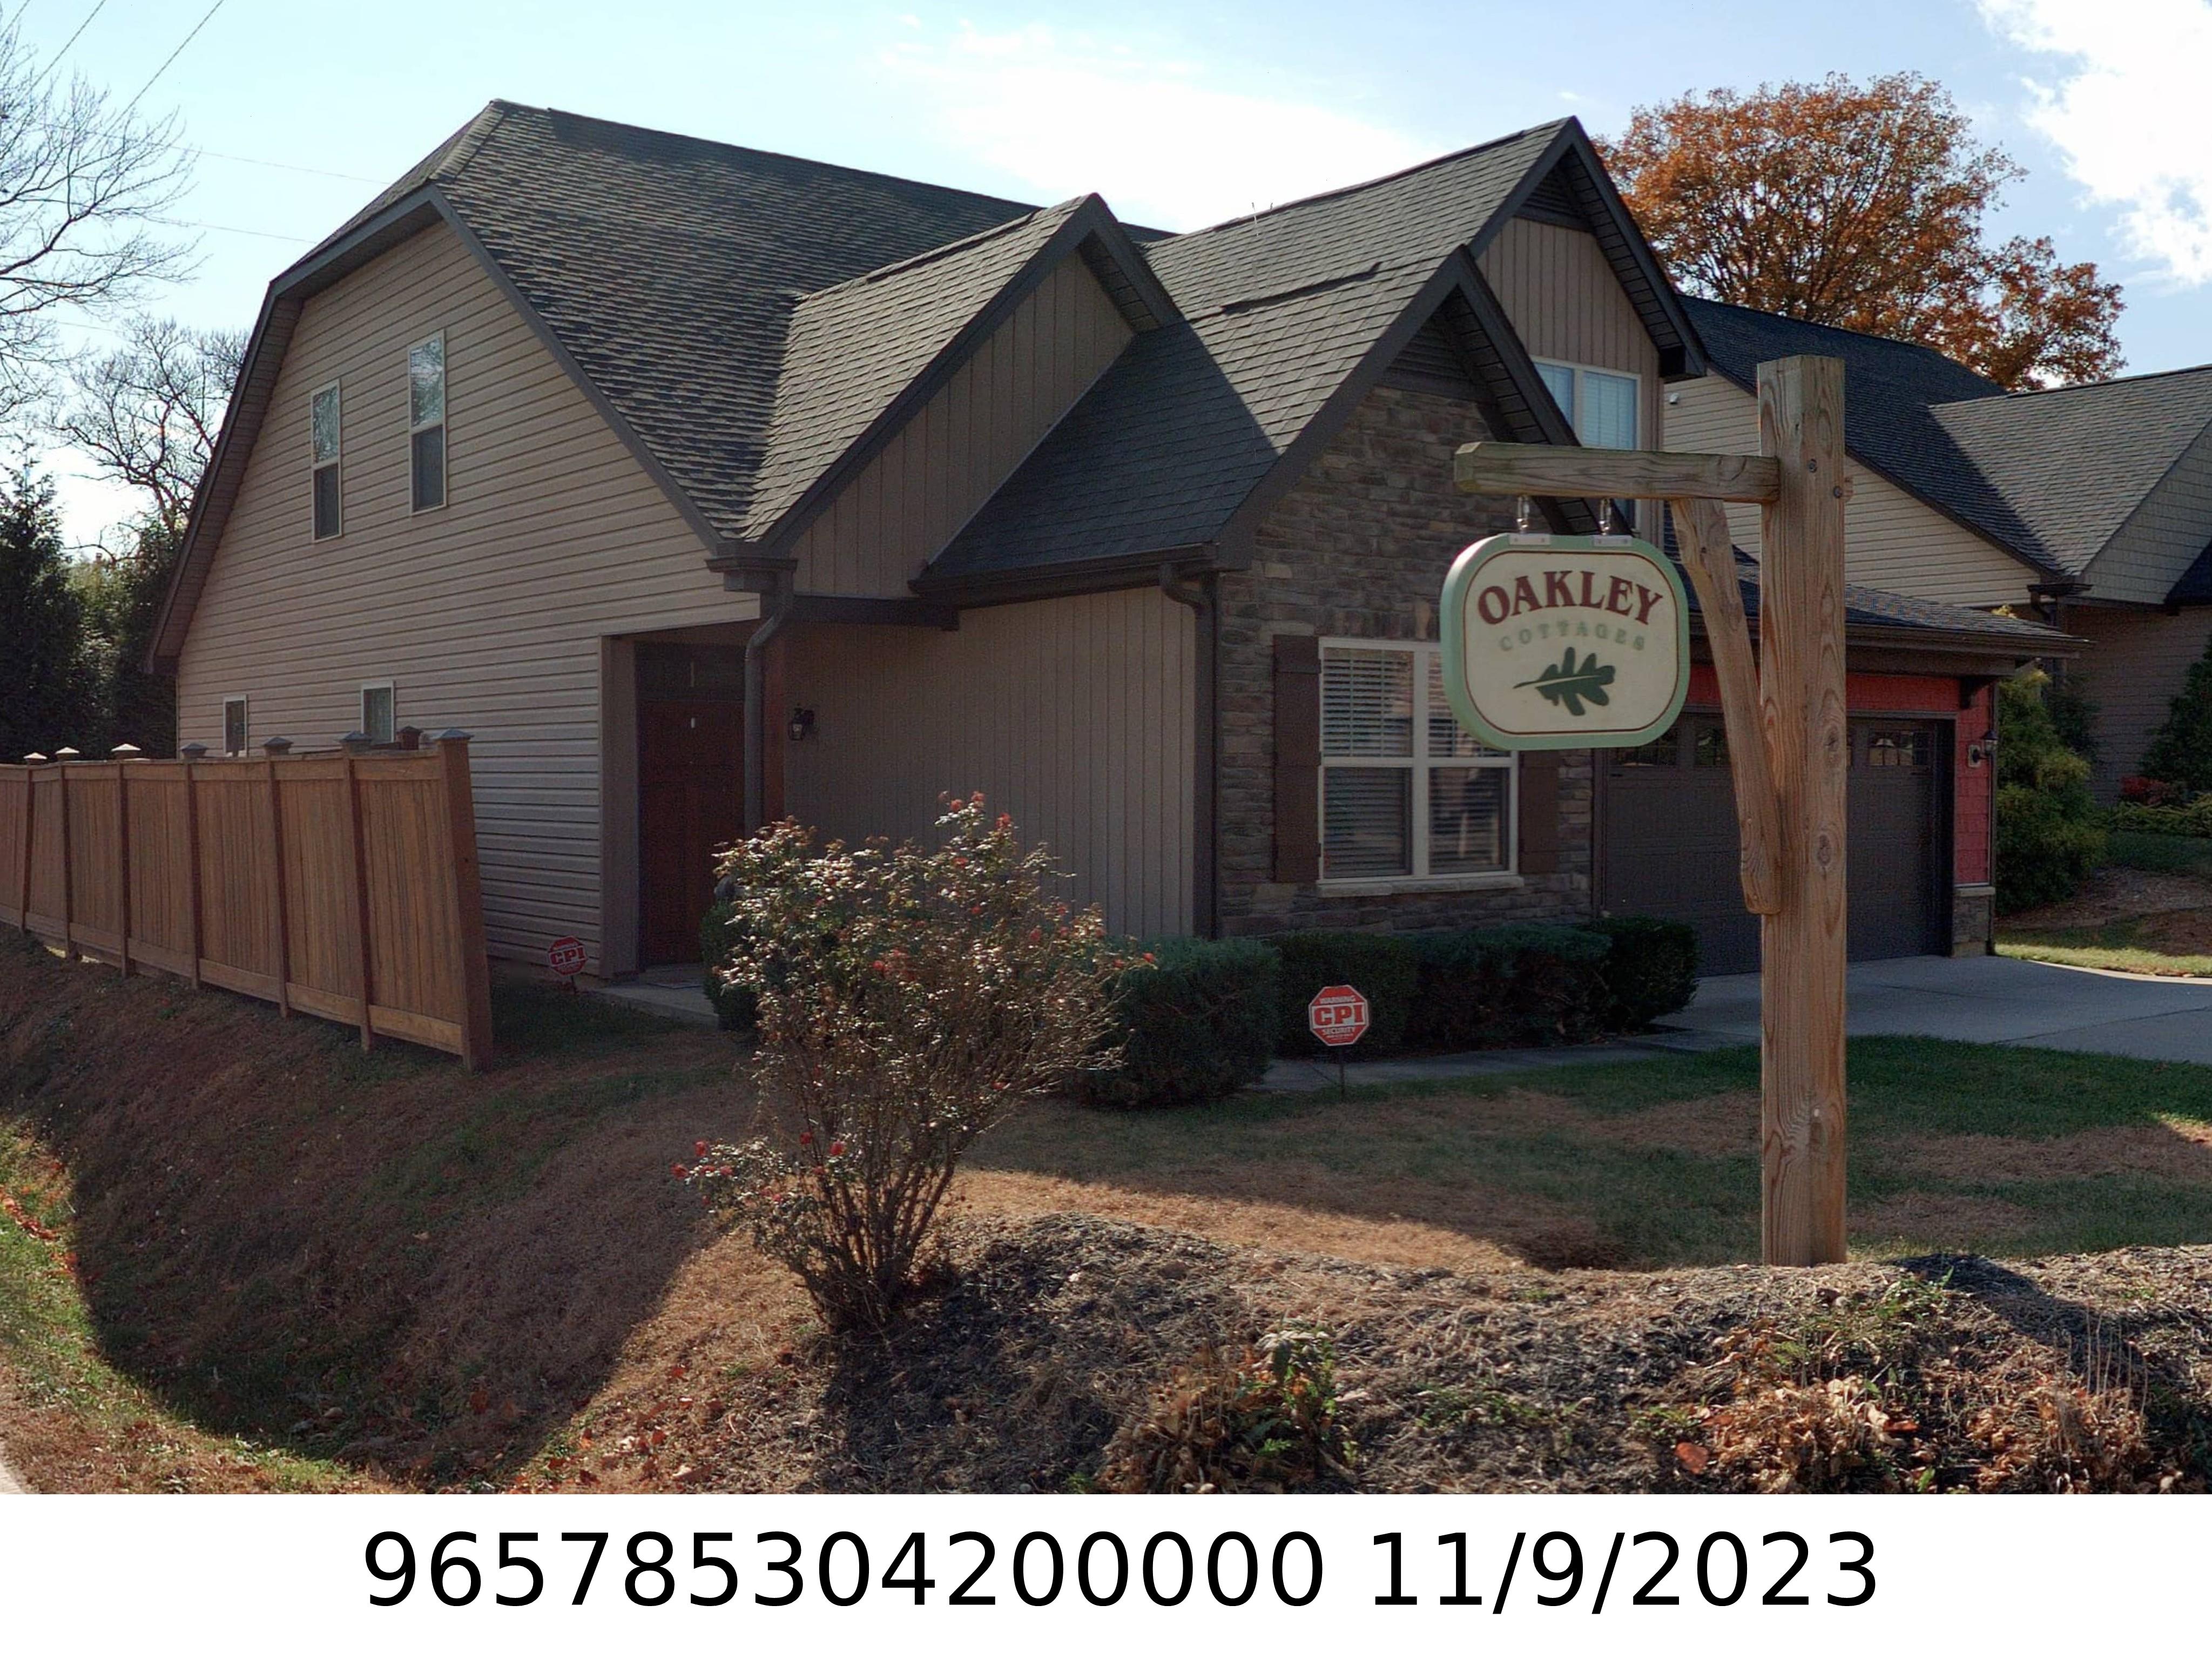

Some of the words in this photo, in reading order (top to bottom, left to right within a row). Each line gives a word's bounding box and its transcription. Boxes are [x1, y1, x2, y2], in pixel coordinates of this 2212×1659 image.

[1478, 570, 1663, 625] OAKLEY
[1499, 621, 1645, 651] COTTAGES
[551, 947, 584, 965] CPI
[1314, 1005, 1364, 1026] CPI
